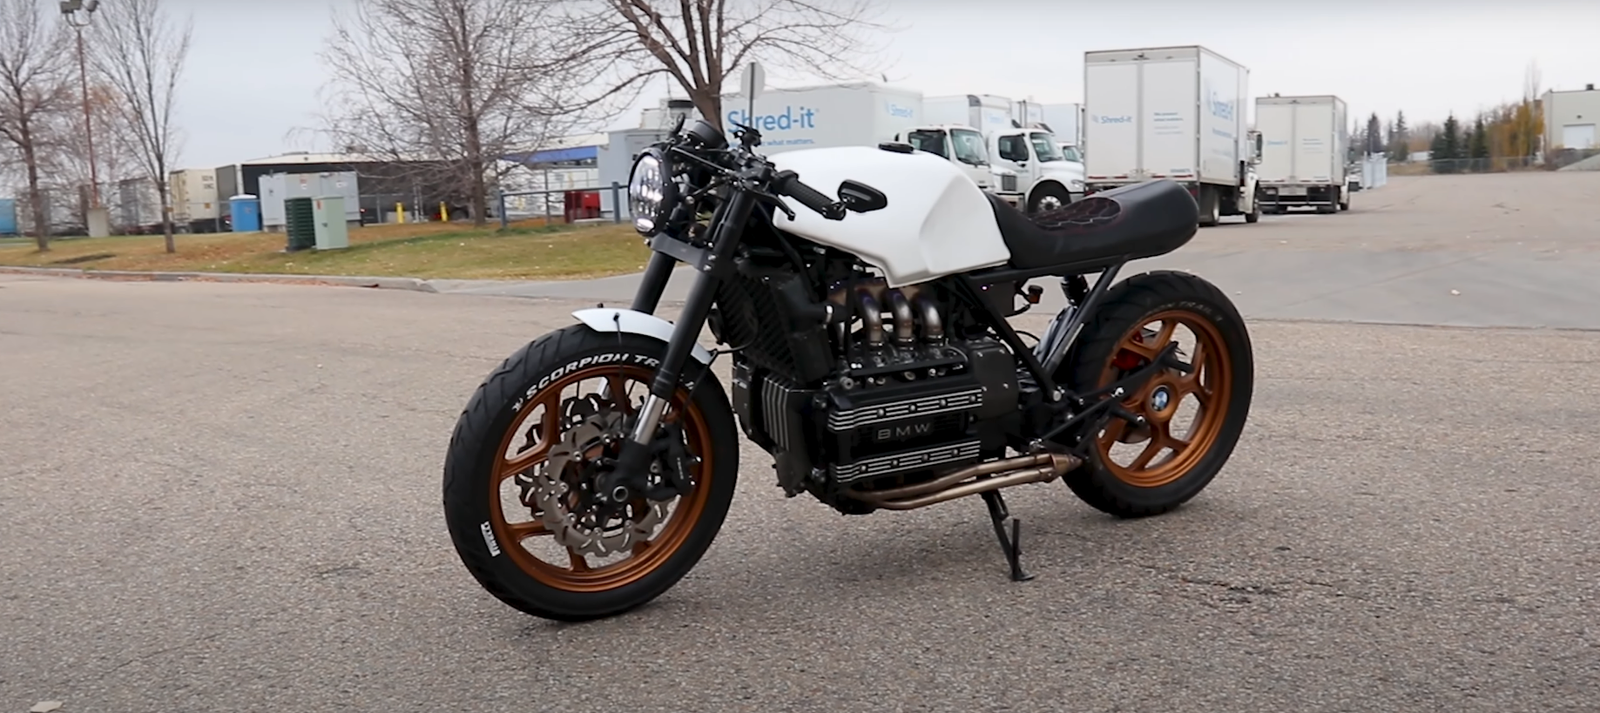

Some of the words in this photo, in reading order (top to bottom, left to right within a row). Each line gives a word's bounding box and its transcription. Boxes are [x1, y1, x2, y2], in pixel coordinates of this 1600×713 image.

[727, 105, 815, 133] Shred-it
[526, 353, 630, 400] SCORPION
[878, 423, 930, 439] BMW
